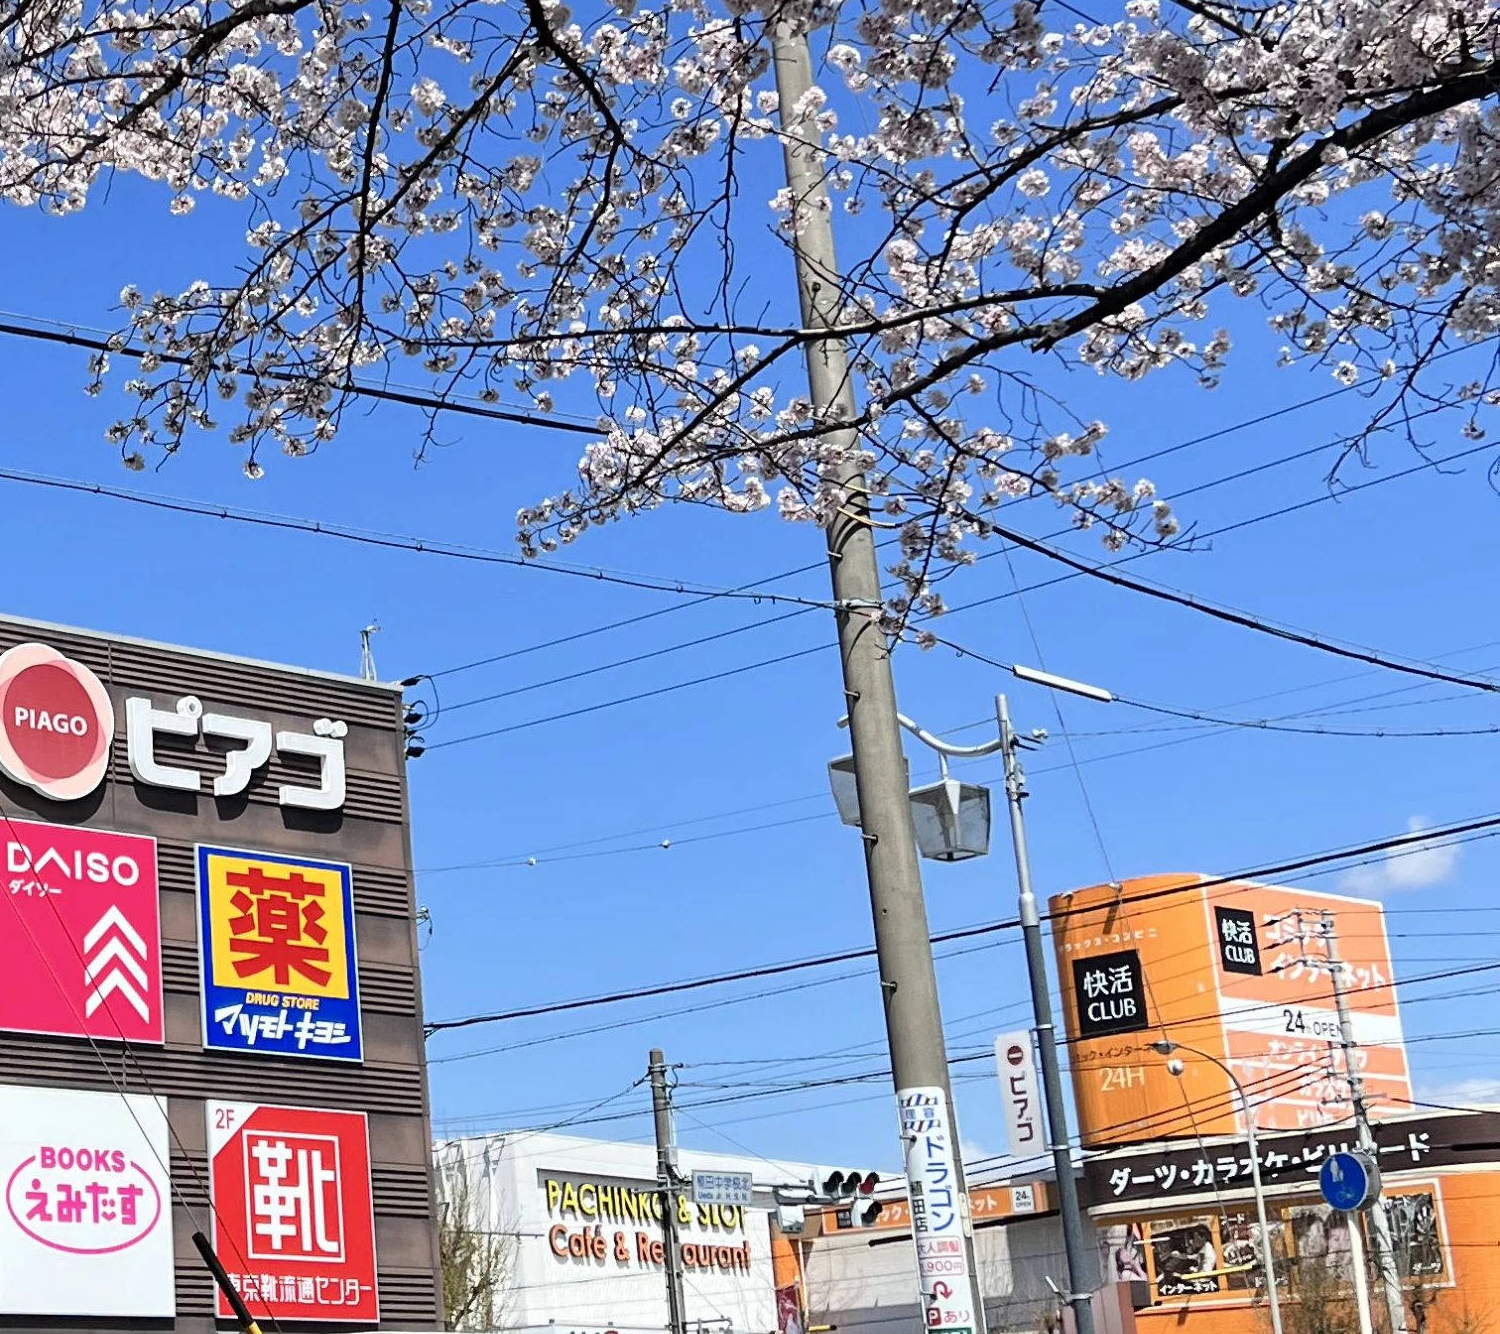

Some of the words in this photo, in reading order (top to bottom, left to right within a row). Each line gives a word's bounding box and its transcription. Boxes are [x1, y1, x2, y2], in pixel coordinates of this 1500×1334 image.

[14, 706, 88, 738] PIAGO
[126, 695, 348, 810] ピアゴ
[7, 841, 140, 886] DAISO
[9, 879, 62, 898] ダイソー
[226, 867, 332, 987] 薬
[1221, 918, 1253, 945] 快活
[1225, 944, 1256, 965] CLUB
[1083, 965, 1133, 999] 快活
[245, 992, 279, 1007] DRUG
[281, 995, 320, 1011] STORE
[1088, 997, 1137, 1022] CLUB
[214, 1003, 352, 1050] マツモトキヨシ
[1099, 1063, 1145, 1092] 24H
[215, 1108, 235, 1130] 2F
[1009, 1070, 1034, 1142] ピアゴ
[40, 1146, 126, 1173] BOOKS
[252, 1139, 339, 1254] 靴
[925, 1134, 955, 1233] ドラゴン
[25, 1178, 143, 1226] えみだす
[678, 1195, 691, 1224] &
[550, 1223, 607, 1259] Café
[614, 1231, 630, 1262] &
[636, 1231, 752, 1271] Reaurant
[943, 1310, 970, 1324] あり
